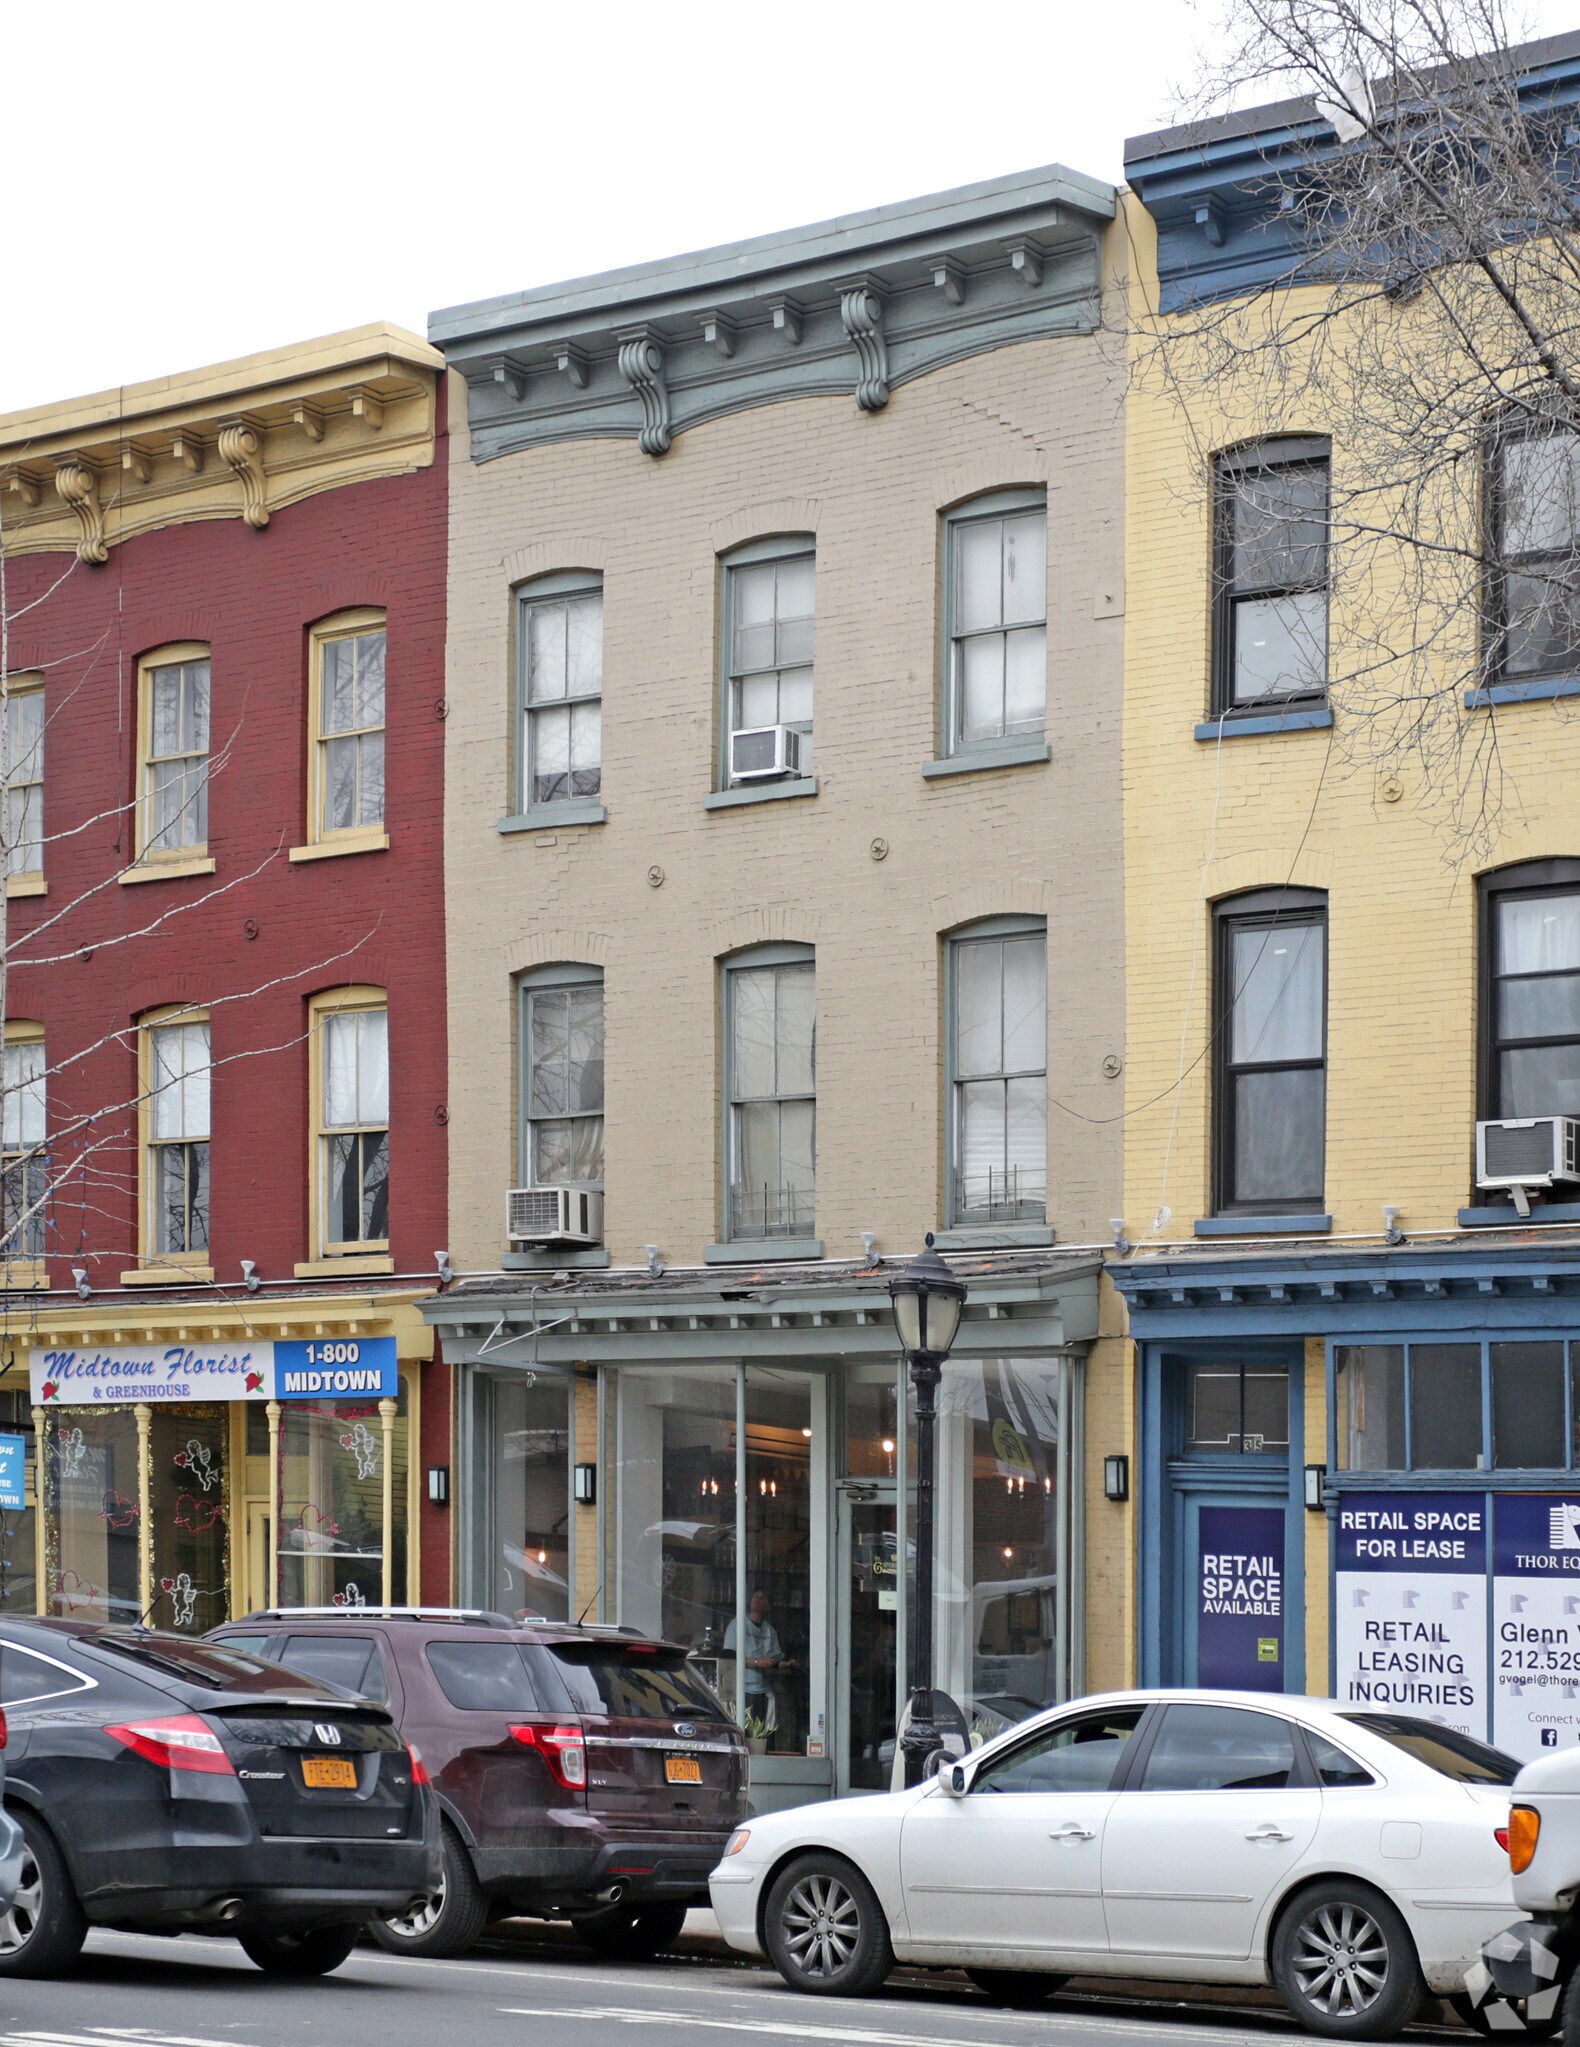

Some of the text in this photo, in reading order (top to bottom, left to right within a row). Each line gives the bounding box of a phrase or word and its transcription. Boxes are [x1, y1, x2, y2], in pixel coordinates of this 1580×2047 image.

[43, 1347, 252, 1381] Midtown Florist
[306, 1343, 360, 1364] 1-800
[93, 1383, 191, 1399] & GREENHOUSE
[285, 1370, 382, 1392] MIDTOWN
[1341, 1512, 1481, 1531] RETAIL SPACE
[1356, 1539, 1465, 1559] FOR LEASE
[1203, 1554, 1280, 1577] RETAIL
[1515, 1555, 1559, 1569] THOR
[1203, 1577, 1281, 1601] SPACE
[1203, 1600, 1281, 1616] AVAILABLE
[1365, 1621, 1450, 1643] RETAIL
[1500, 1622, 1568, 1644] Glenn
[1359, 1651, 1464, 1675] LEASING
[1349, 1681, 1475, 1706] INQUIRIES
[1528, 1712, 1573, 1725] Connect
